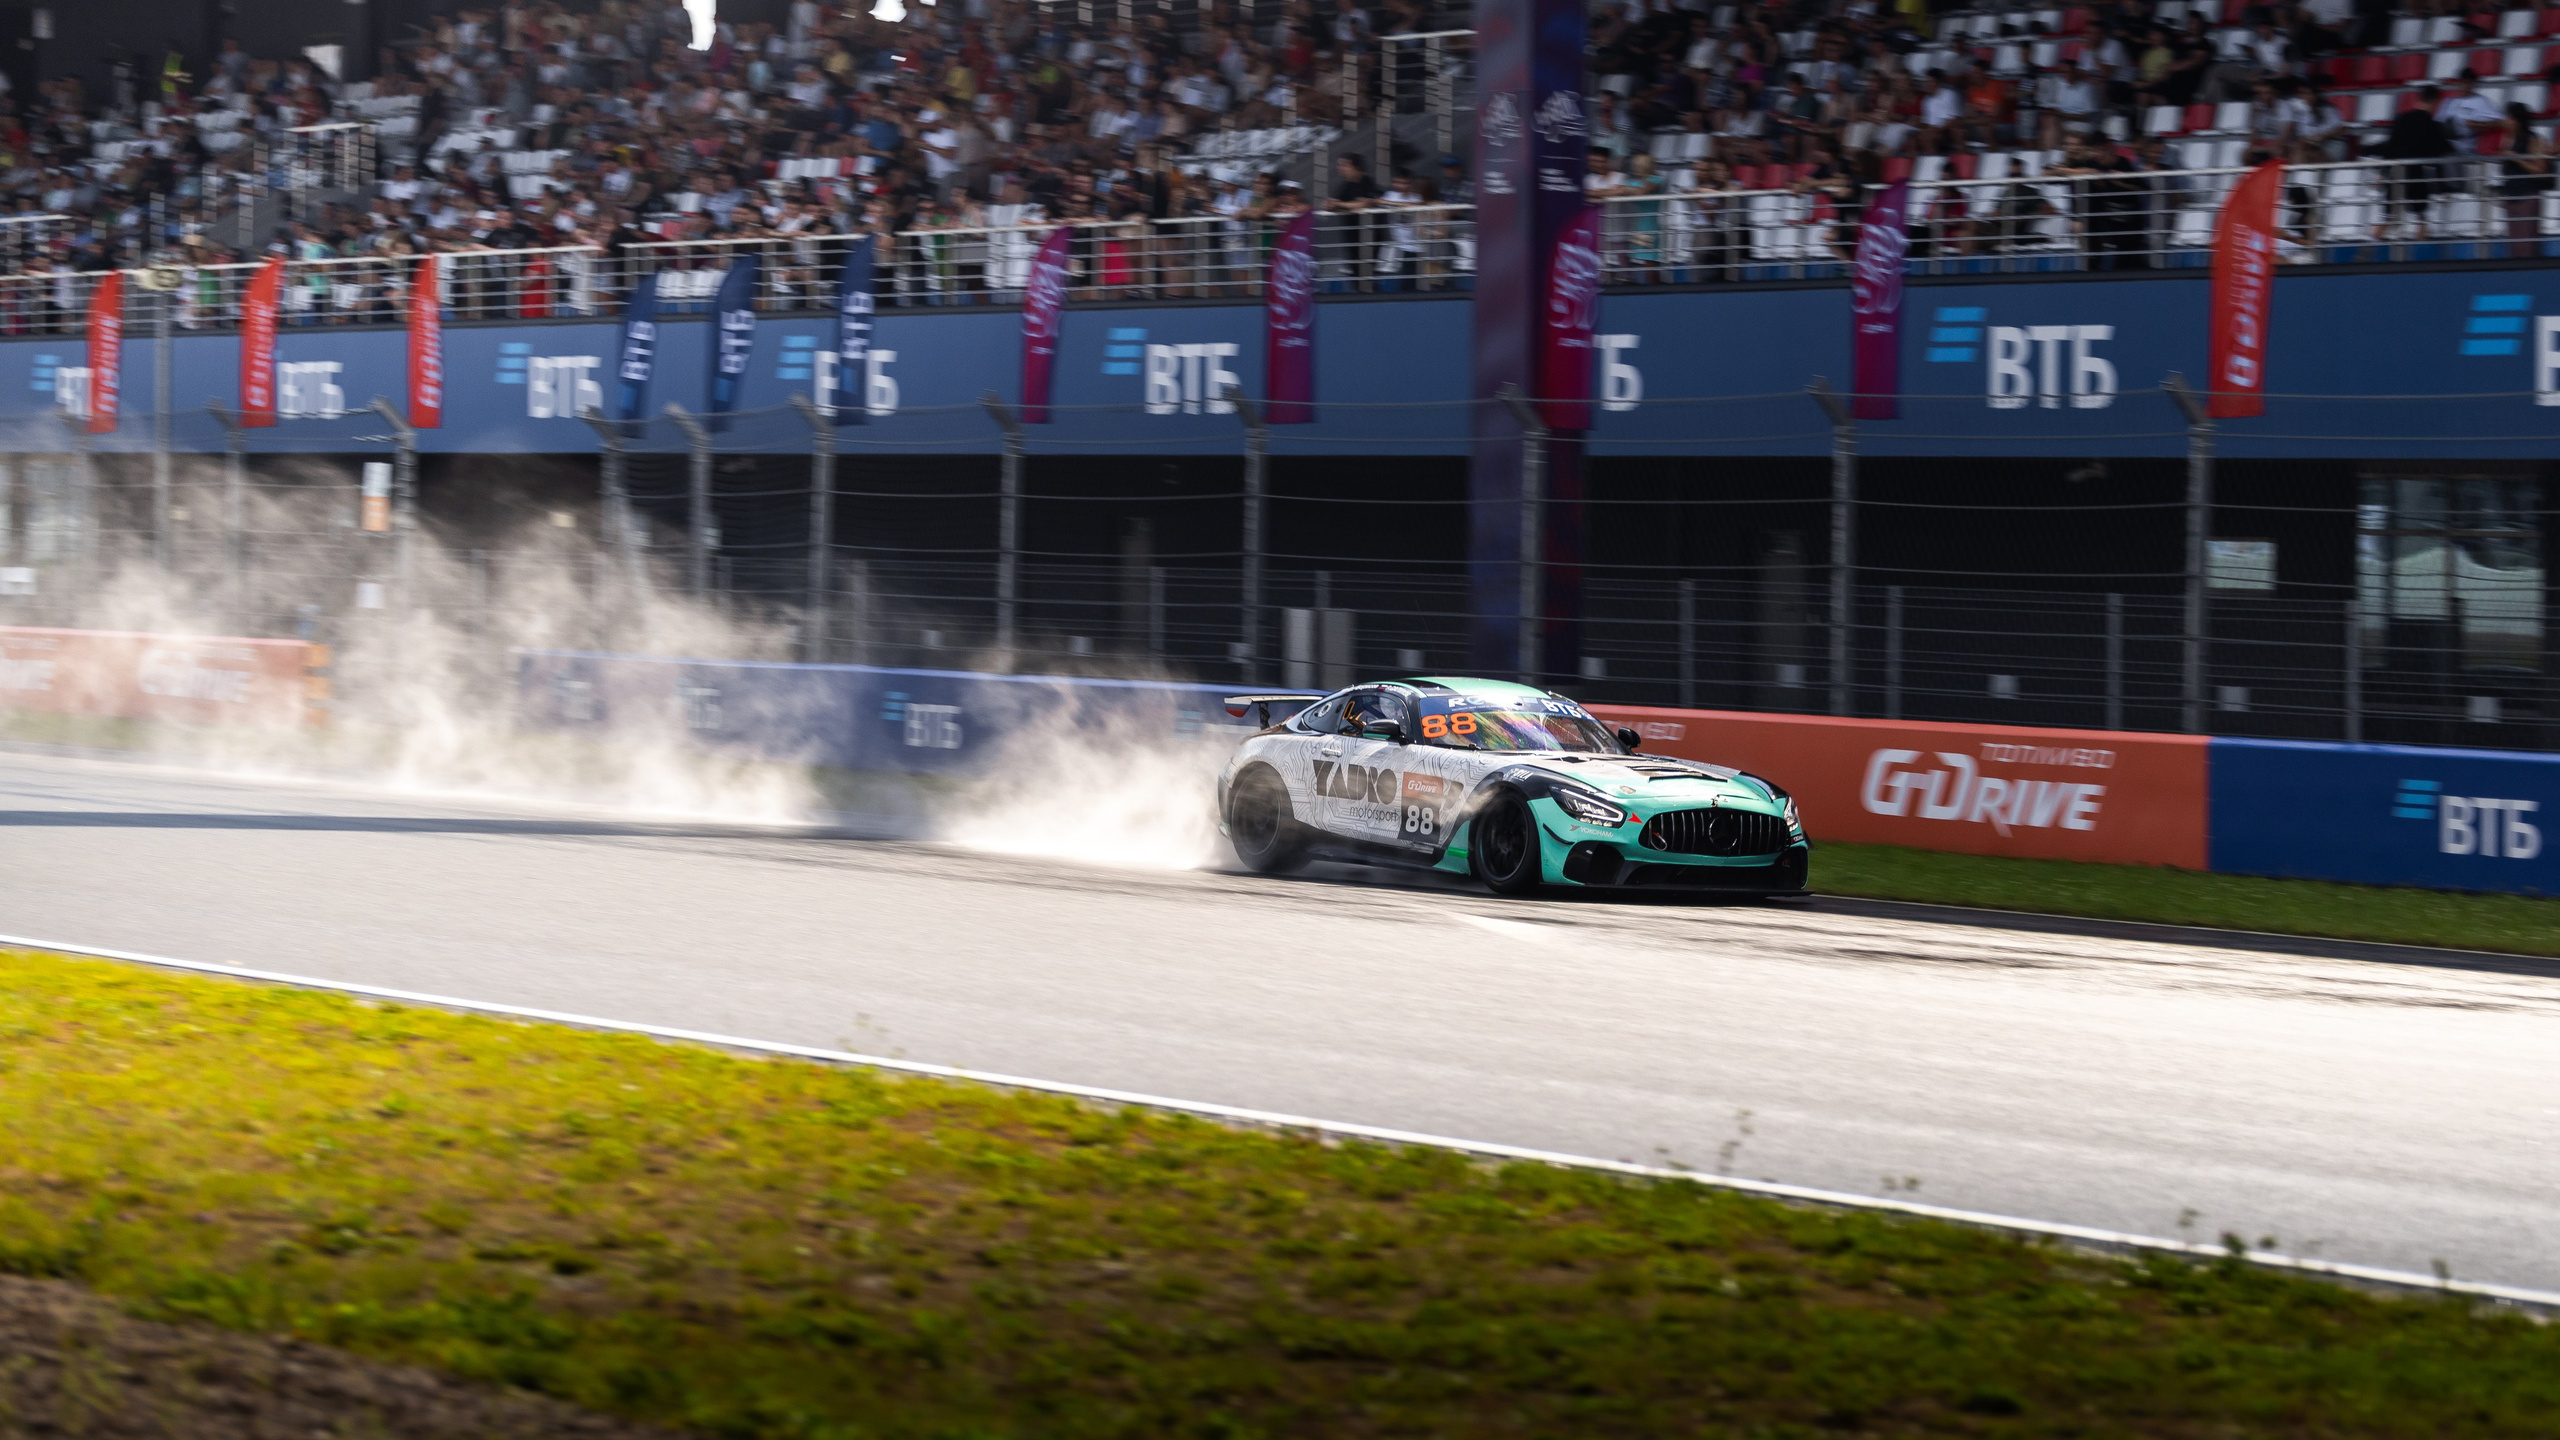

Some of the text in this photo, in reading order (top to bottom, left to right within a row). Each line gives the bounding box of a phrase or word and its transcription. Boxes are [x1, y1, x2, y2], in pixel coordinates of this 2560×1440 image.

[528, 356, 603, 418] ВТБ
[815, 348, 899, 415] ВБ
[1146, 342, 1239, 415] ВТБ
[1987, 325, 2117, 410] ВТБ
[904, 703, 961, 750] ВТБ
[1421, 712, 1477, 738] 88
[1543, 699, 1582, 719] ВТБ
[1349, 805, 1399, 823] motorsport
[1405, 805, 1434, 836] 88
[2438, 794, 2543, 859] ВТБ
